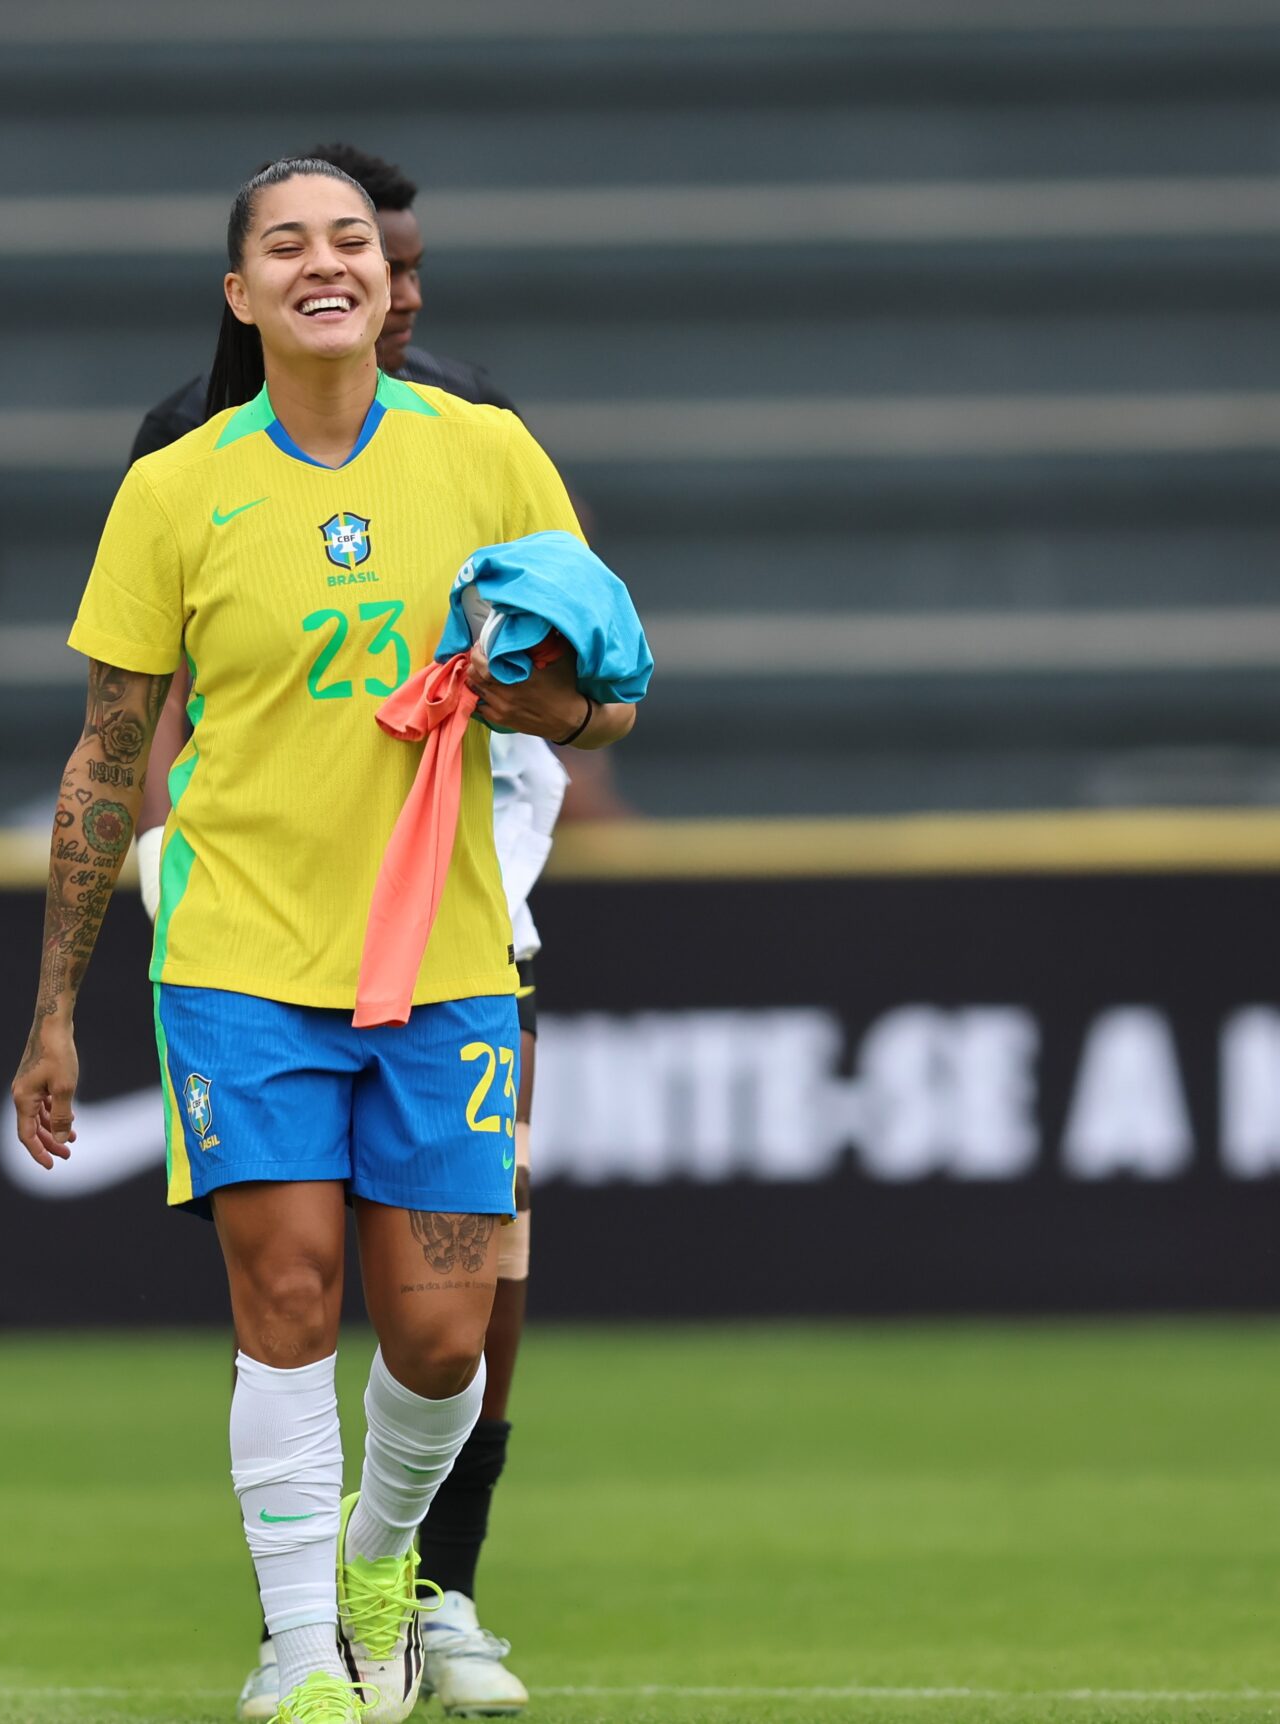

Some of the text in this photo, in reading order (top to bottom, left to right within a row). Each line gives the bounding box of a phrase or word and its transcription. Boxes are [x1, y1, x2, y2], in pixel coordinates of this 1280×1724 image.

[327, 571, 380, 587] BRASIL
[337, 534, 356, 543] CBF
[302, 600, 411, 700] 23
[460, 1041, 517, 1138] 23
[1060, 1003, 1197, 1182] A
